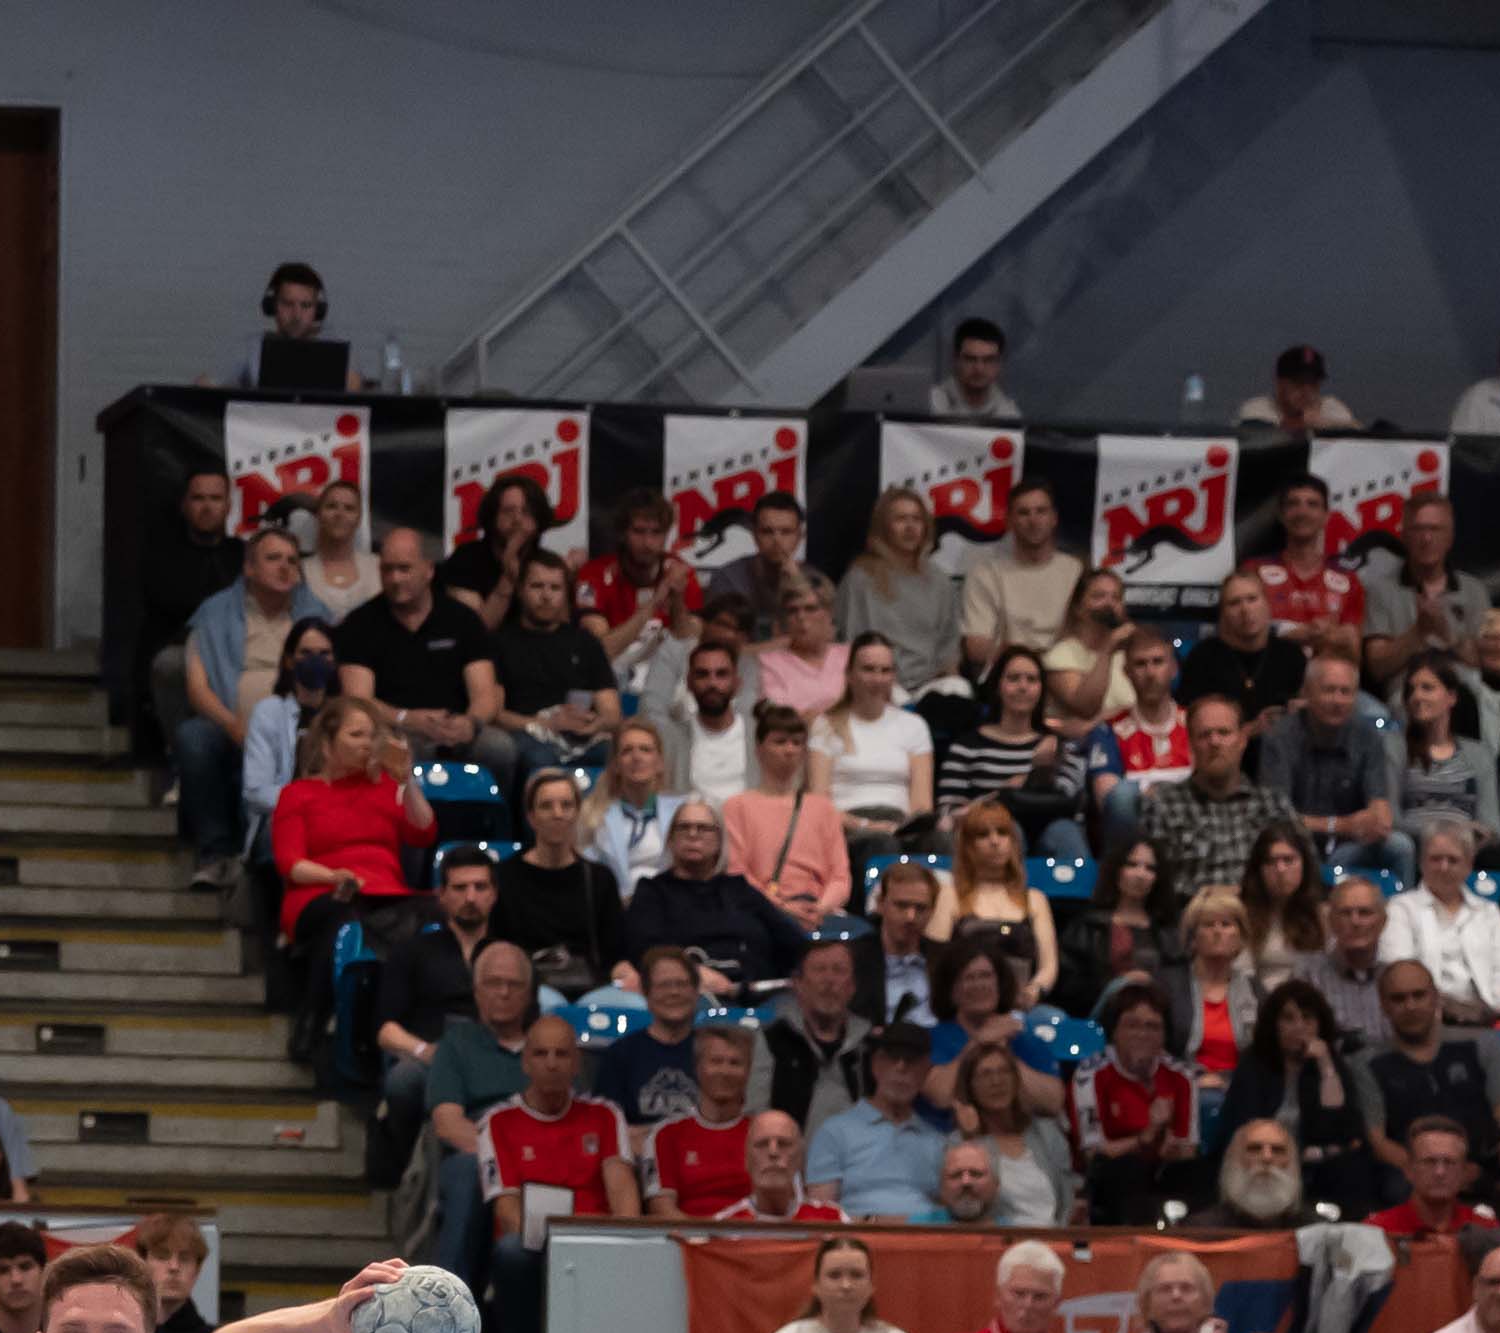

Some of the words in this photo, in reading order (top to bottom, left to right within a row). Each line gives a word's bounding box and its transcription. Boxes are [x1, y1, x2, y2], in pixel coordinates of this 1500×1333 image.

[234, 433, 331, 469] ENERGY
[453, 439, 552, 481] ENERGY
[673, 447, 768, 487] ENERGY
[889, 456, 985, 491] NERGY
[930, 436, 1014, 533] RJ
[1103, 464, 1201, 503] ENERGY
[1332, 471, 1410, 503] NERGY
[1101, 445, 1230, 567] NRJ
